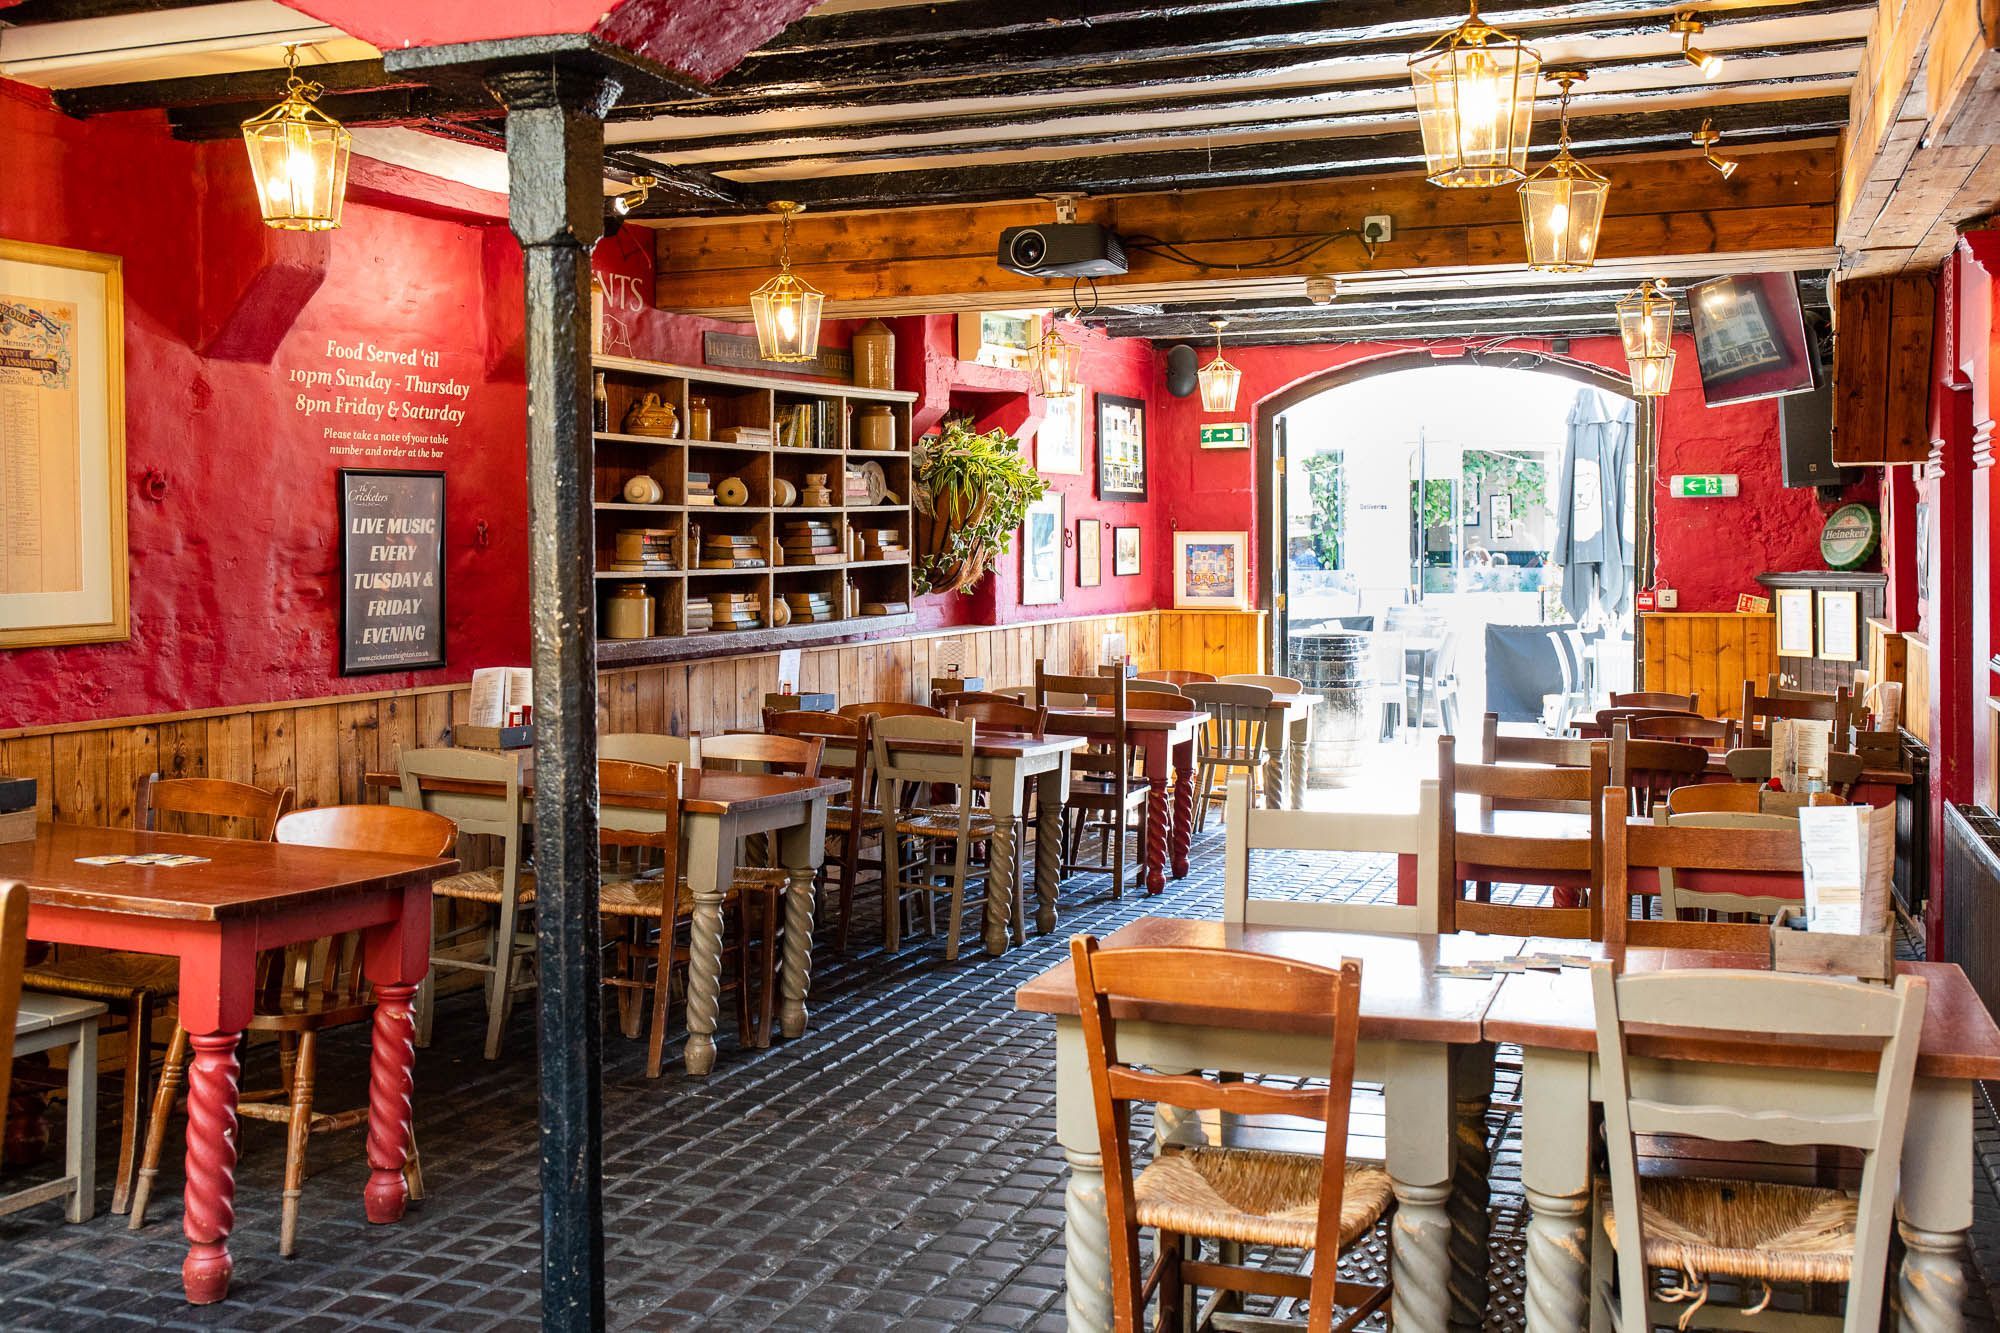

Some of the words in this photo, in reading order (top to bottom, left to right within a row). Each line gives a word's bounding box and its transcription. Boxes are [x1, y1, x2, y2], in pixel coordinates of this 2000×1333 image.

[591, 269, 644, 312] NTS
[325, 340, 364, 361] Food
[367, 345, 417, 366] Served
[289, 369, 332, 388] 10pm
[335, 368, 392, 394] Sunday
[404, 375, 470, 400] Thursday
[295, 393, 331, 416] 8pm
[335, 396, 384, 421] Friday
[387, 400, 399, 418] &
[401, 402, 466, 427] Saturday
[323, 427, 351, 440] Please
[353, 430, 371, 441] take
[373, 433, 379, 441] a
[381, 431, 400, 443] note
[402, 432, 411, 445] of
[409, 433, 428, 445] your
[429, 433, 449, 445] table
[329, 445, 364, 456] number
[365, 446, 382, 457] and
[383, 446, 407, 458] order
[408, 448, 417, 458] at
[417, 447, 430, 459] the
[431, 448, 444, 459] bar
[348, 485, 388, 502] Cricketers
[351, 517, 385, 535] LIVE
[386, 517, 437, 535] MUSIC
[1825, 528, 1867, 540] Heineken
[369, 545, 418, 562] EVERY
[353, 571, 421, 590] TUESDAY
[422, 571, 434, 588] &
[367, 598, 422, 617] FRIDAY
[362, 624, 426, 645] EVENING
